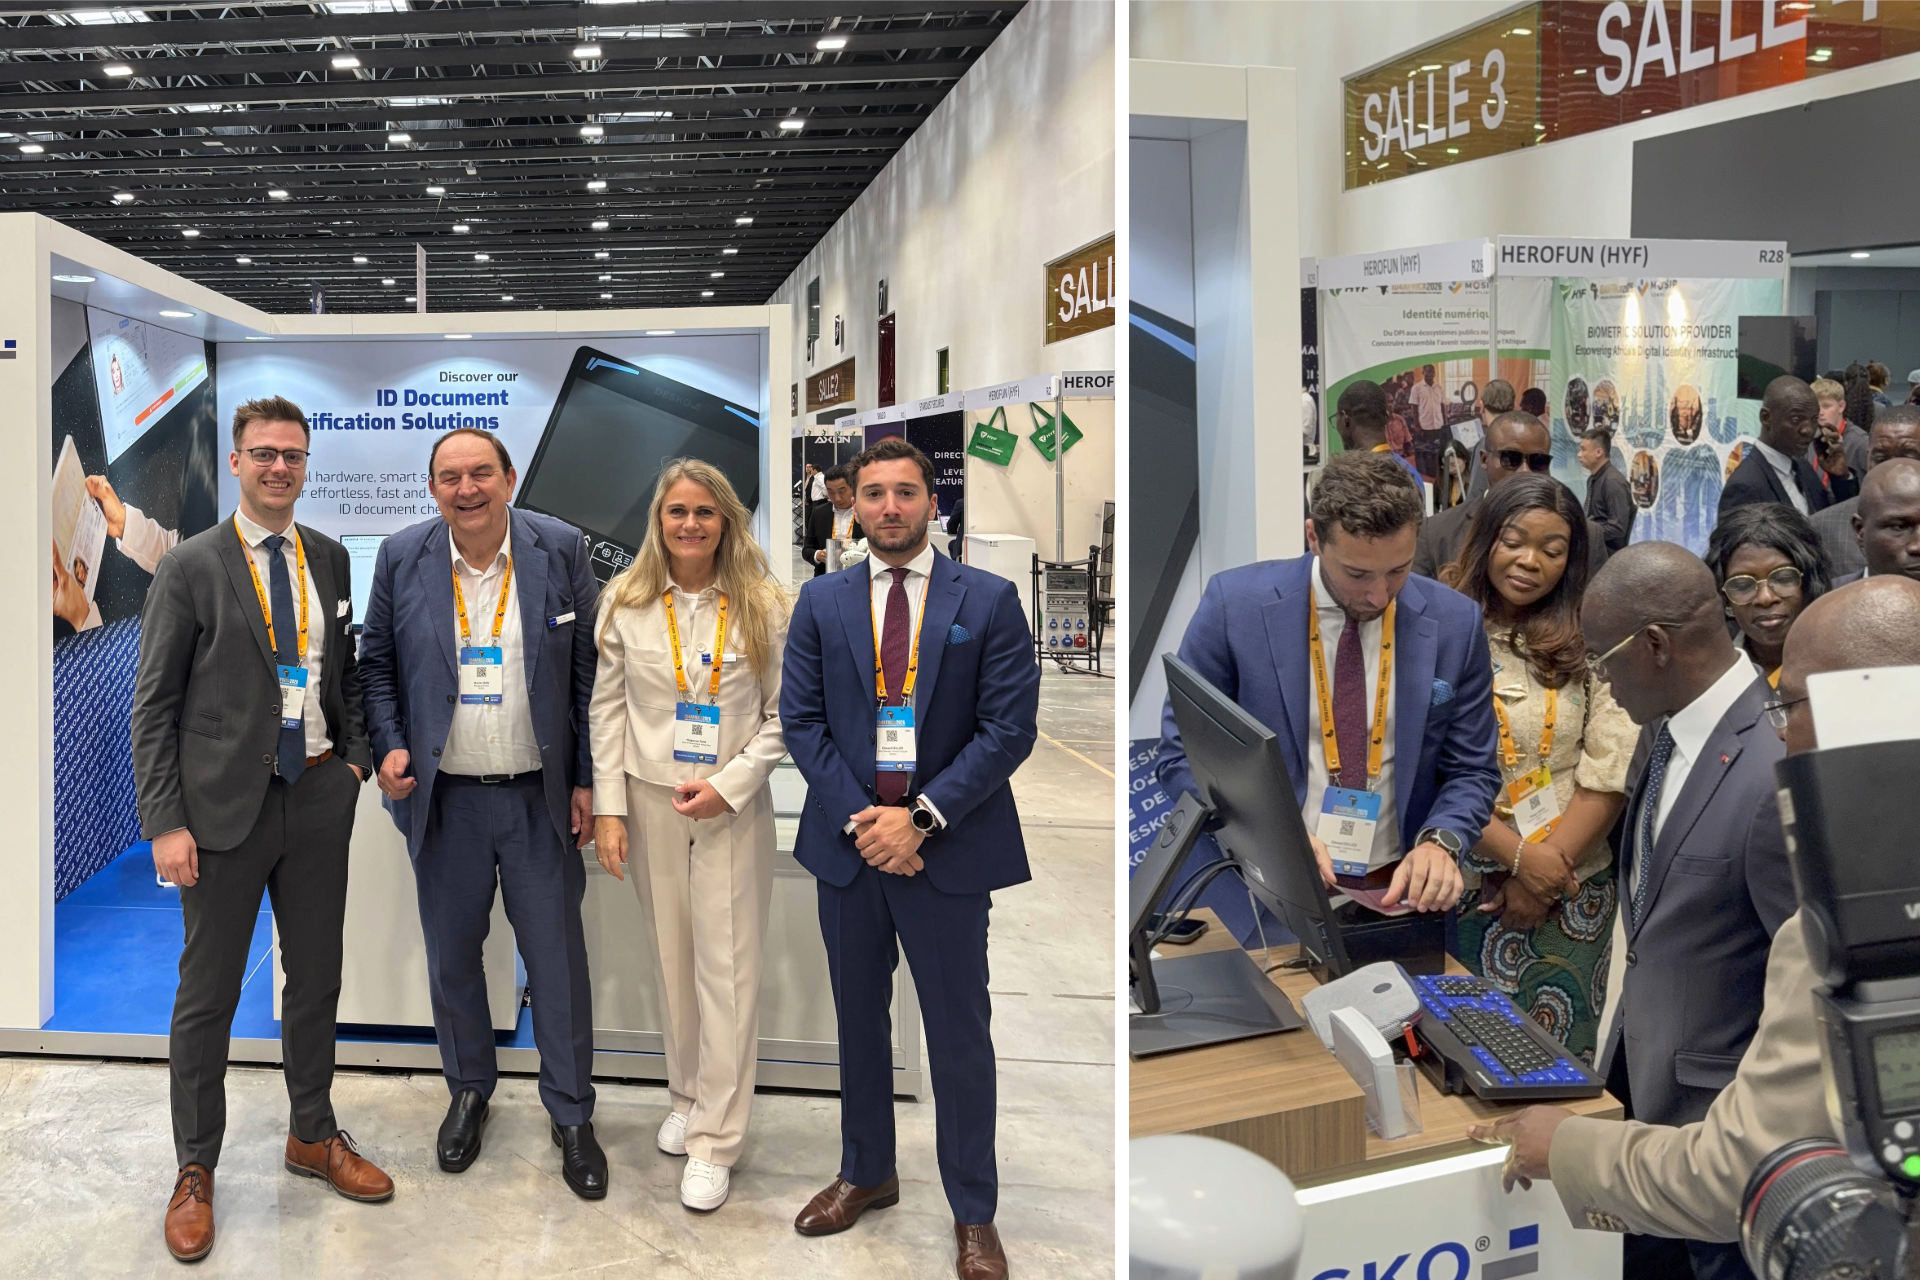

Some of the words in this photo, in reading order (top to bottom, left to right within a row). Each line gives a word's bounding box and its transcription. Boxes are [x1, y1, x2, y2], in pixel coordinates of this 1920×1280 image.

[1362, 58, 1471, 162] SALLE
[1481, 48, 1506, 130] 3
[1501, 245, 1594, 264] HEROFUN
[1600, 244, 1648, 268] (HYF)
[1759, 249, 1784, 264] R28
[1364, 258, 1398, 276] HEROFUN
[1400, 252, 1420, 275] (HYF)
[1402, 308, 1442, 319] Identité
[1444, 308, 1490, 321] numériqu
[1418, 329, 1457, 338] écosystèmes
[1459, 329, 1480, 338] publics
[1588, 326, 1629, 338] BIOMETRIC
[1632, 325, 1677, 338] SOLUTION
[1680, 325, 1732, 338] PROVIDER
[1460, 339, 1489, 347] numériqu
[1576, 344, 1612, 358] Empowering
[1694, 346, 1738, 359] Infrastruct
[439, 371, 493, 382] Discover
[496, 373, 518, 382] our
[819, 374, 835, 402] SALLE
[835, 372, 839, 396] 2
[376, 389, 398, 406] ID
[404, 389, 508, 406] Document
[306, 412, 396, 430] rification
[402, 412, 499, 430] Solutions
[315, 471, 376, 484] hardware,
[380, 472, 418, 483] smart
[310, 486, 373, 500] effortless,
[376, 487, 399, 499] fast
[403, 487, 426, 499] and
[339, 503, 350, 515] ID
[354, 502, 417, 515] document
